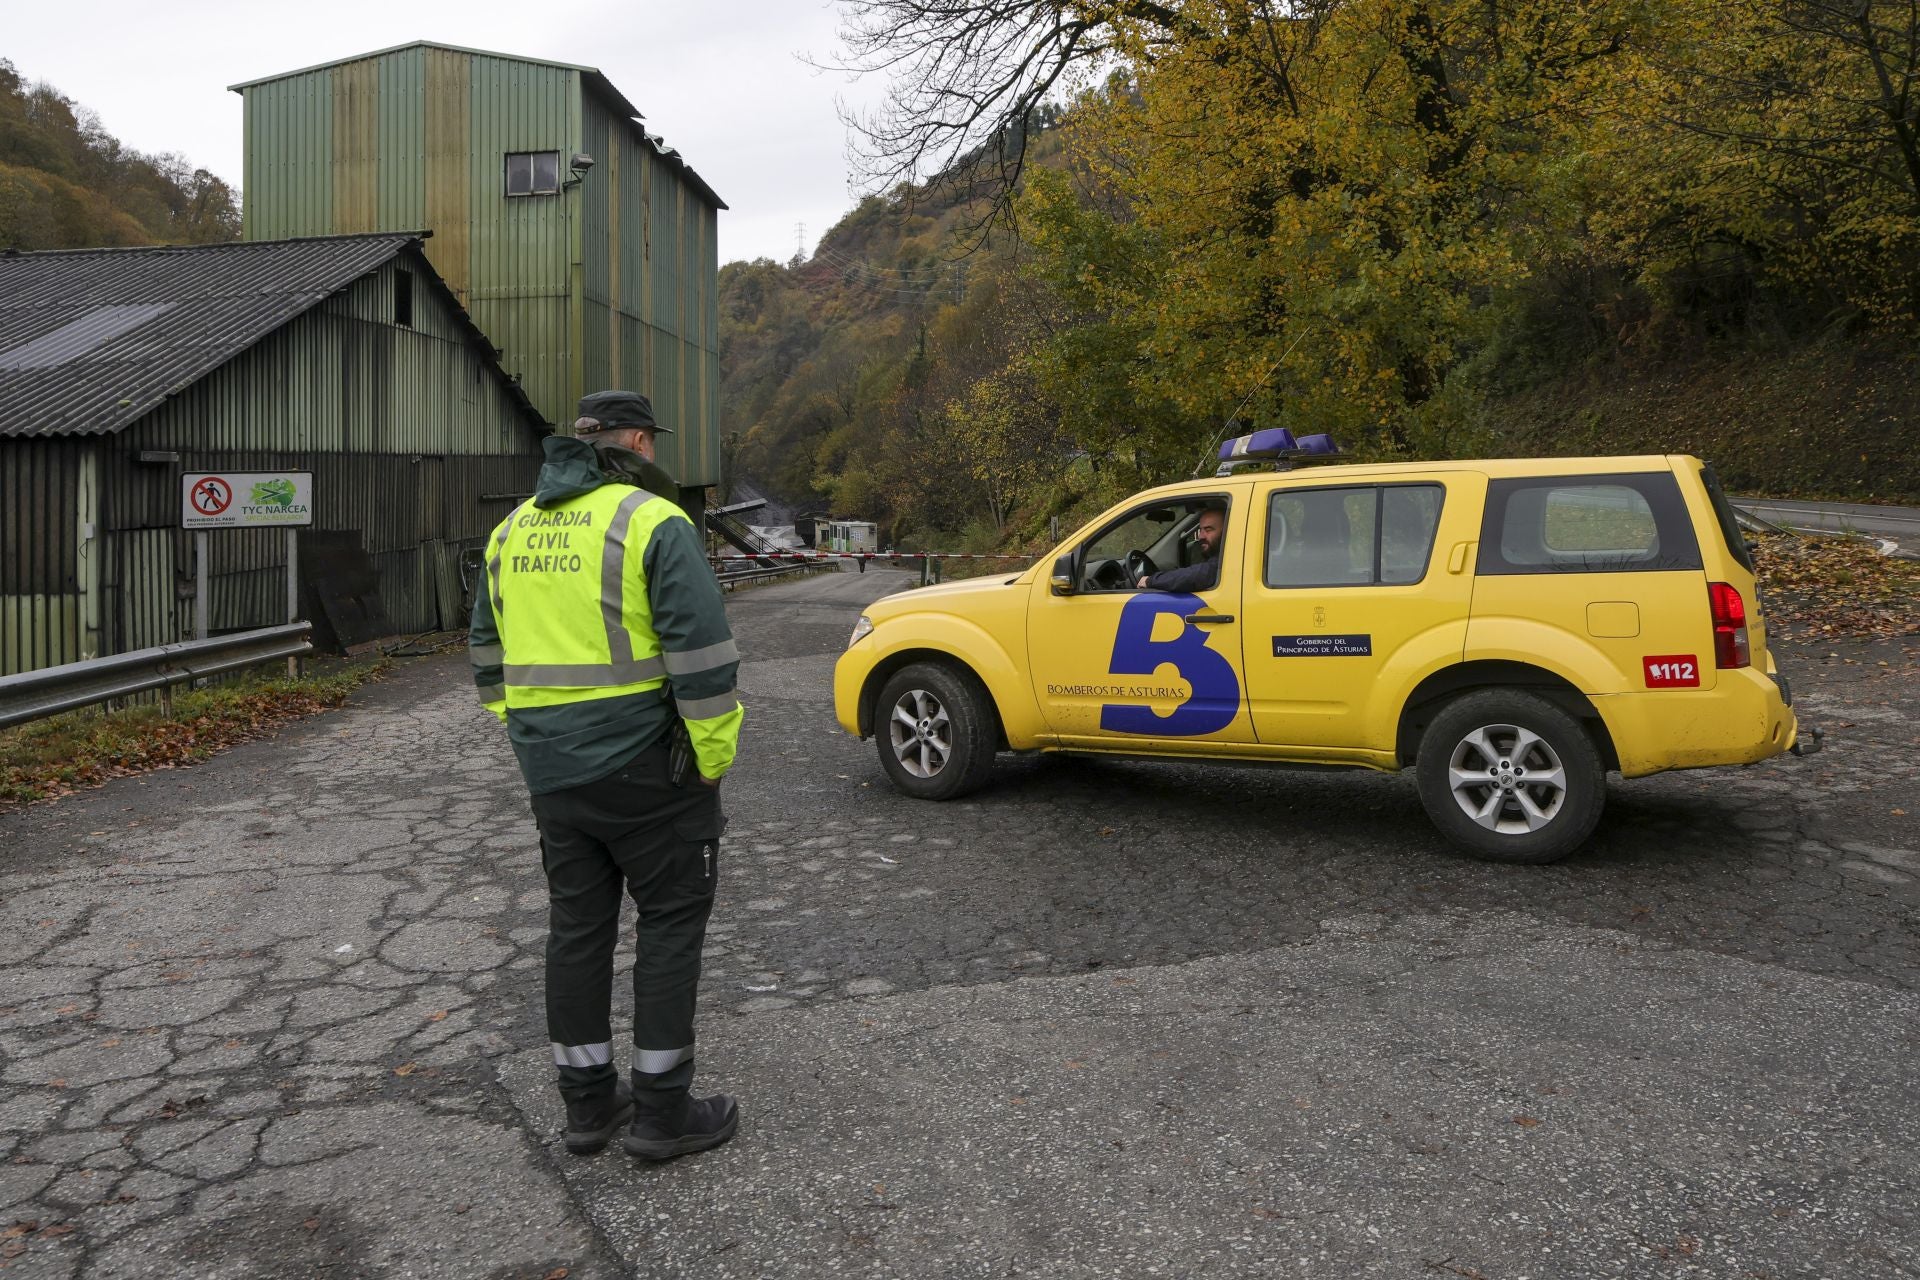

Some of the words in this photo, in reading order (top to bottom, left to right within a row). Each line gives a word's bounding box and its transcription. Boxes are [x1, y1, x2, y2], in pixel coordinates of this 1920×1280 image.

[242, 506, 262, 514] TYC
[265, 505, 307, 514] NARCEA
[518, 511, 592, 528] GUARDIA
[526, 532, 570, 550] CIVIL
[512, 554, 581, 573] TRAFICO
[1277, 646, 1319, 654] PRINCIPADO
[1333, 645, 1368, 653] ASTURIAS
[1661, 663, 1694, 679] 112
[1047, 684, 1109, 696] BOMBEROS
[1110, 686, 1125, 696] DE
[1128, 686, 1185, 698] ASTURIAS
